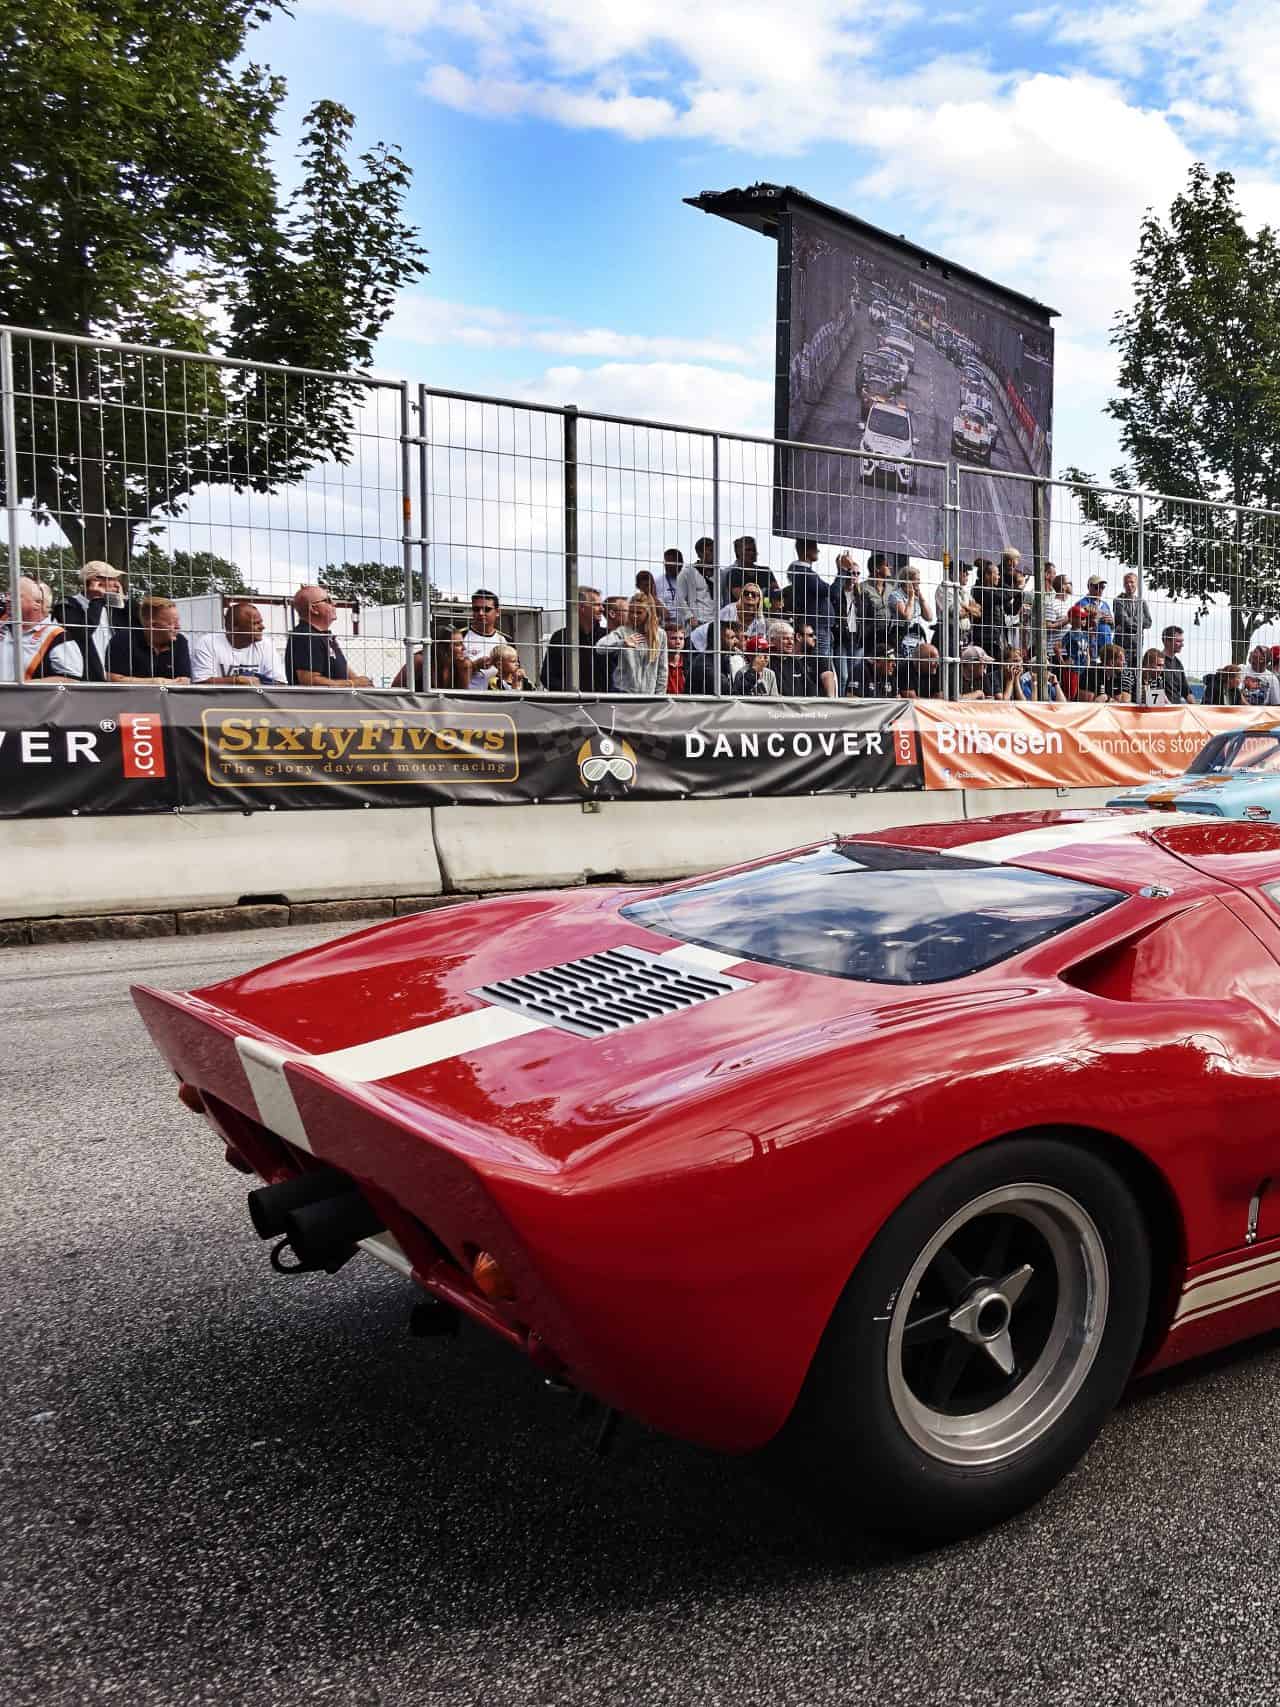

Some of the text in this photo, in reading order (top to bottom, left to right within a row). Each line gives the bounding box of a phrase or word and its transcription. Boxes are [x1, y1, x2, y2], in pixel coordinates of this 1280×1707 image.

[132, 717, 155, 775] .com
[219, 718, 506, 759] SixtyFivers
[685, 732, 884, 758] DANCOVER
[936, 722, 1063, 754] Bilbasen
[1078, 731, 1213, 753] Danmarks størs
[219, 760, 506, 776] The glory days of motor racing
